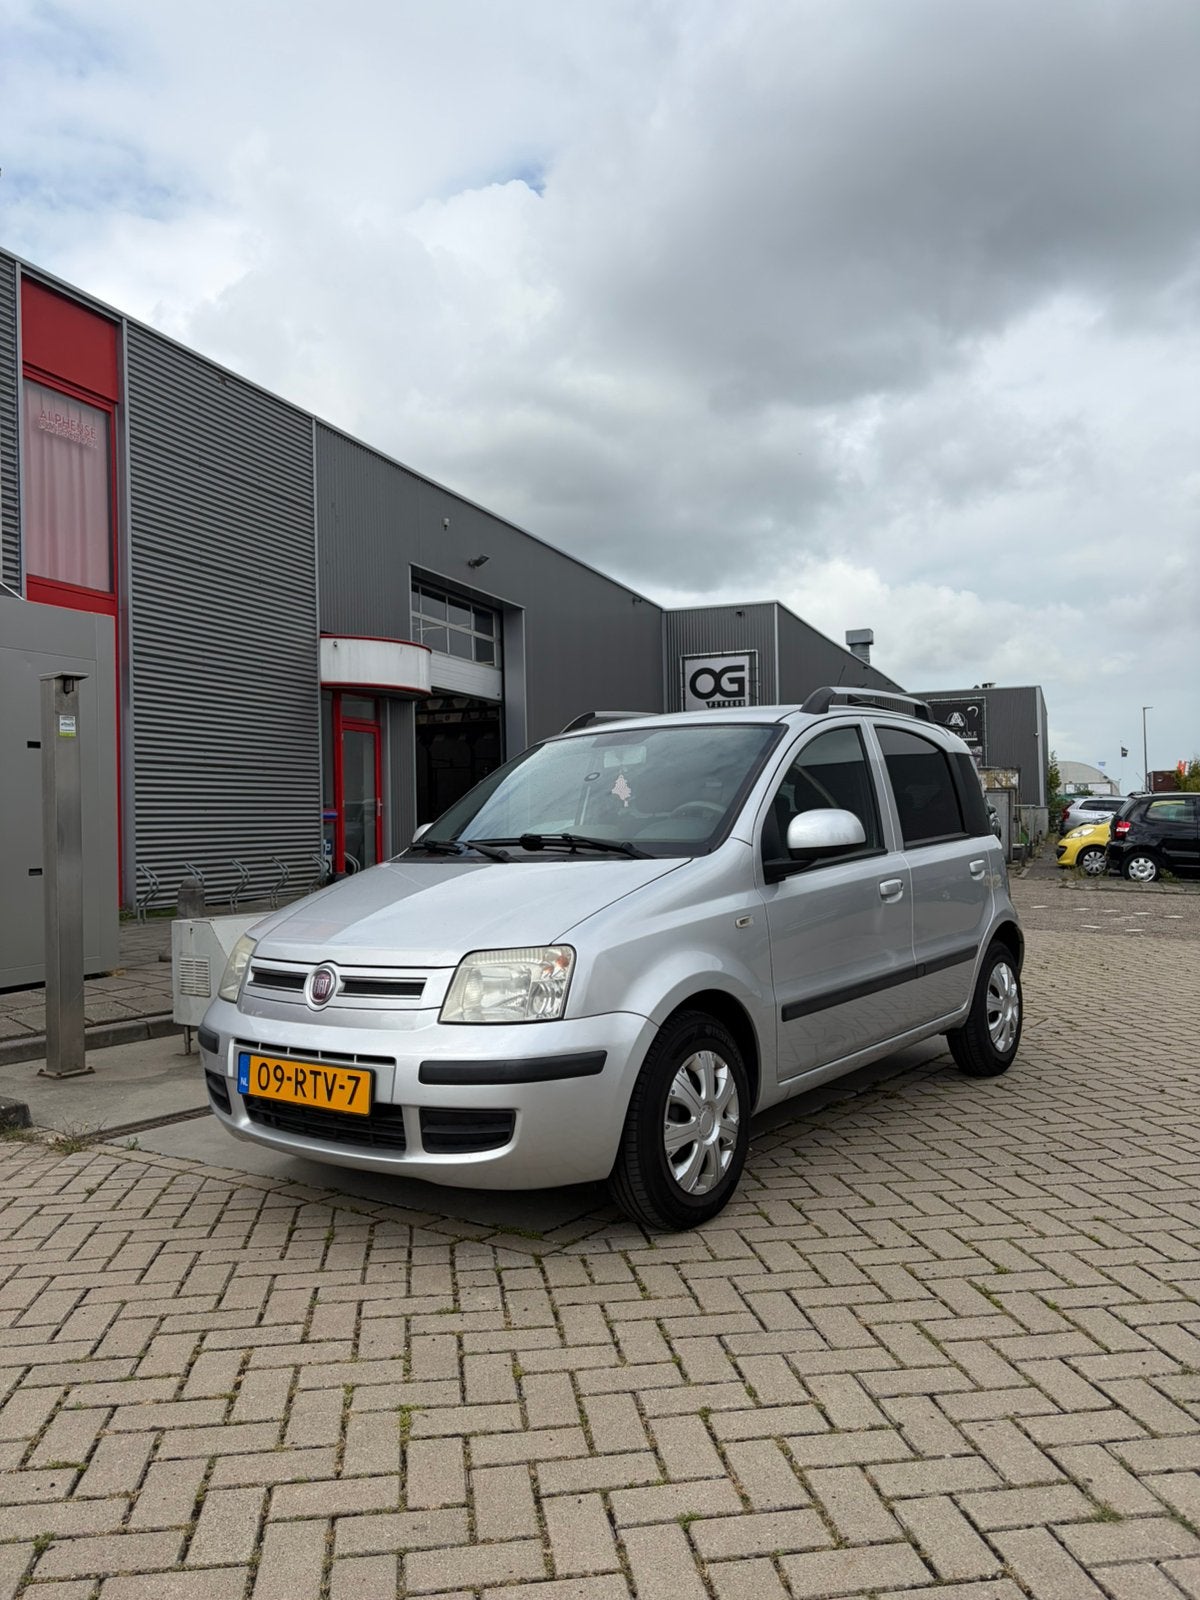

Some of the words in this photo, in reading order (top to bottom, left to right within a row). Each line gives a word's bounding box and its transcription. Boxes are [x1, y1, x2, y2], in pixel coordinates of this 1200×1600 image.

[689, 665, 745, 700] OG
[240, 1076, 249, 1087] NL
[257, 1062, 361, 1106] 09-RTV-7
